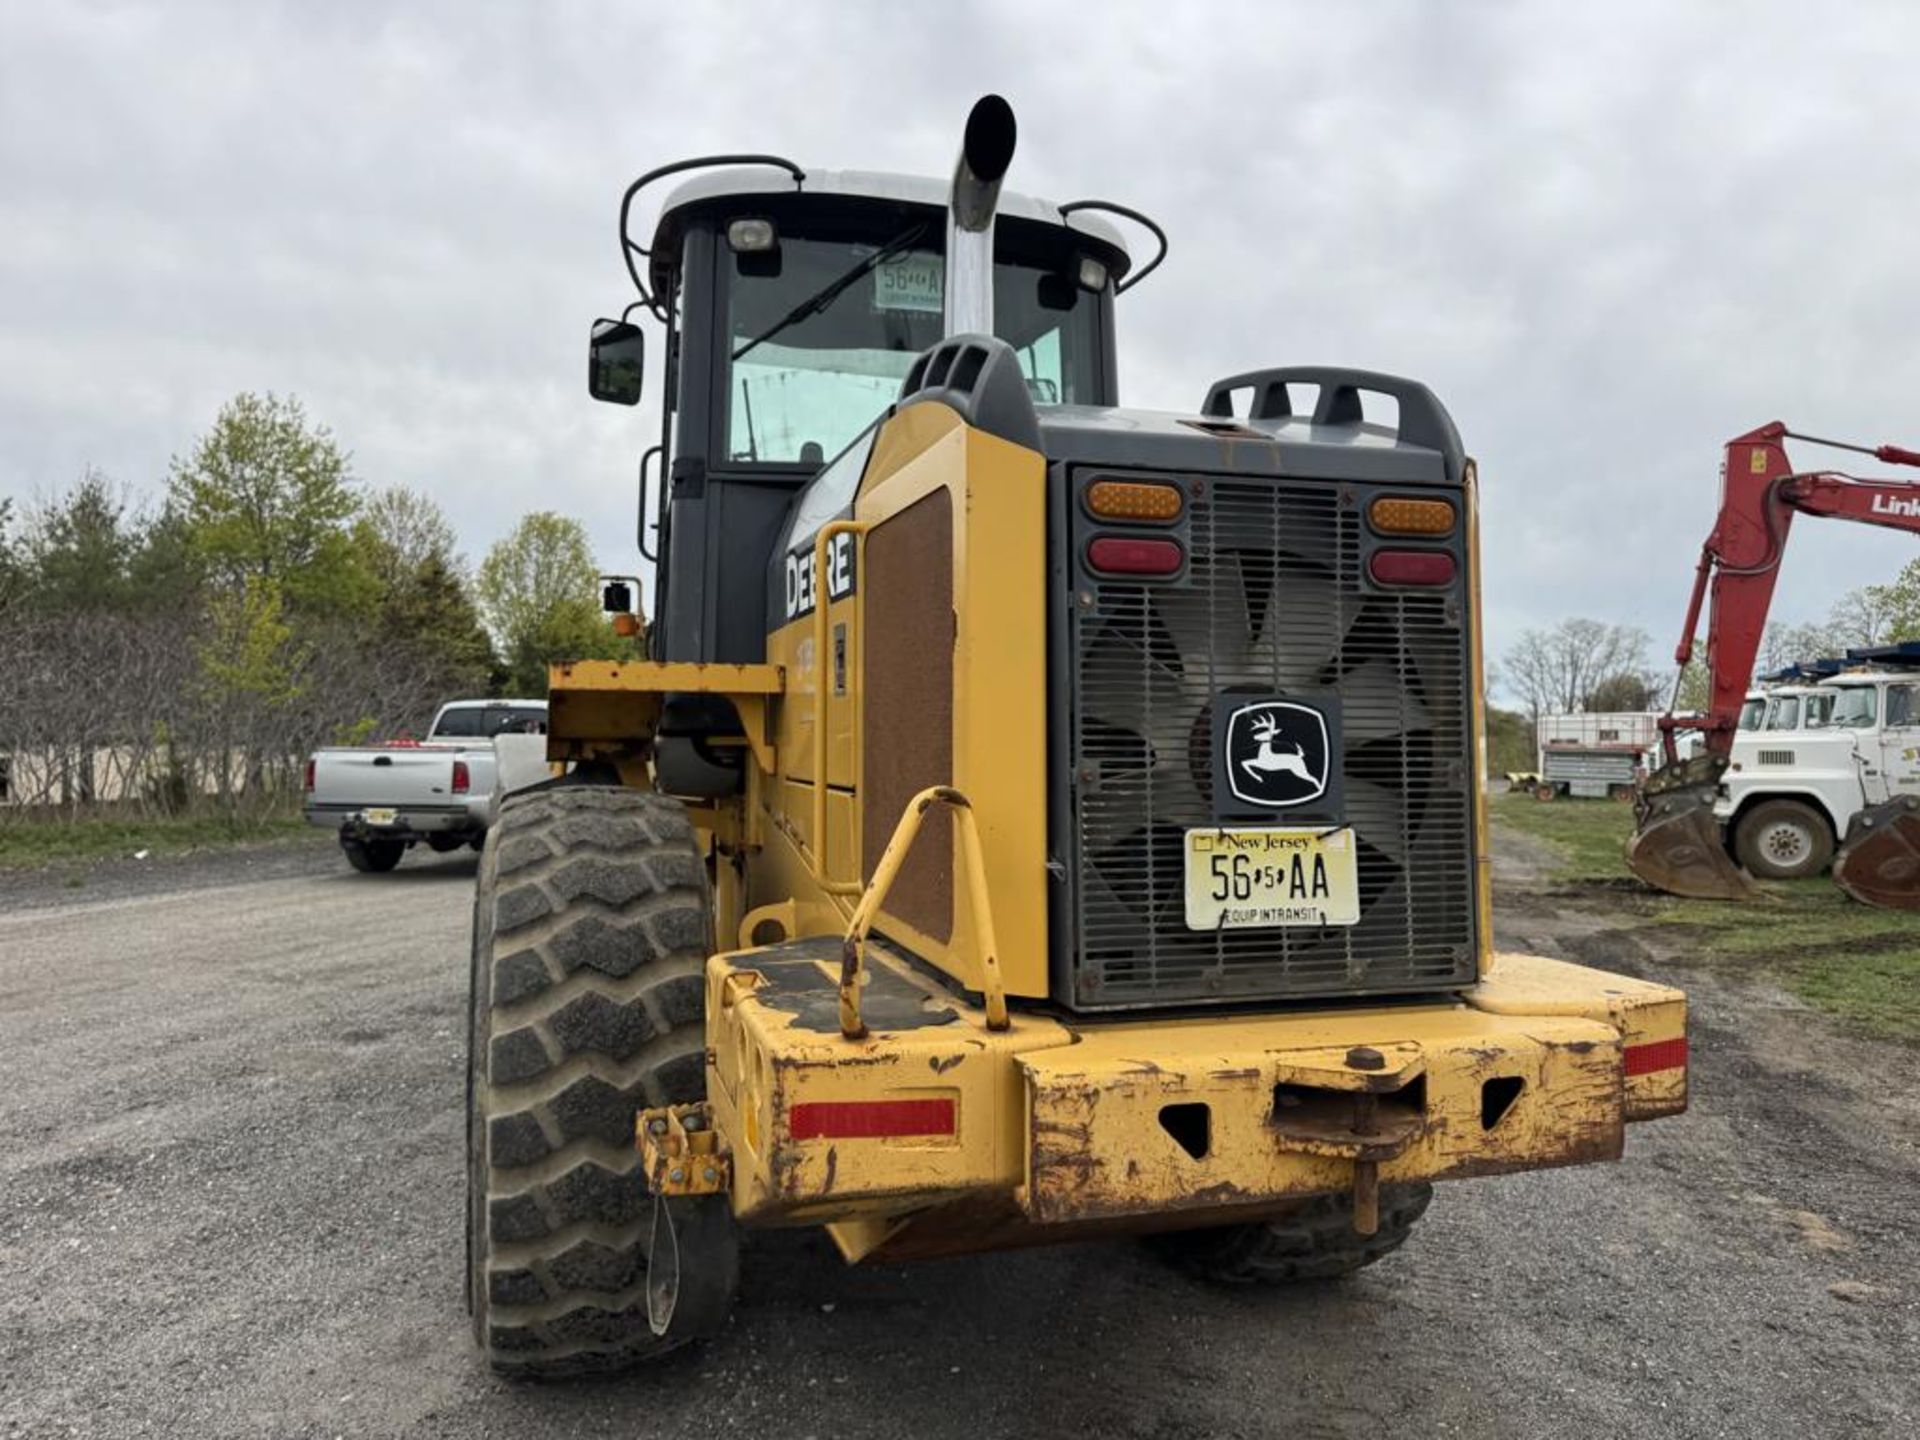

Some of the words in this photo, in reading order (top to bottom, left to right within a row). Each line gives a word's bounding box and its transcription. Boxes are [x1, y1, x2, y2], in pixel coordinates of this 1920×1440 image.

[1226, 834, 1261, 849] New
[1263, 833, 1311, 852] Jersey
[1211, 854, 1251, 900] 56
[1289, 853, 1330, 899] AA
